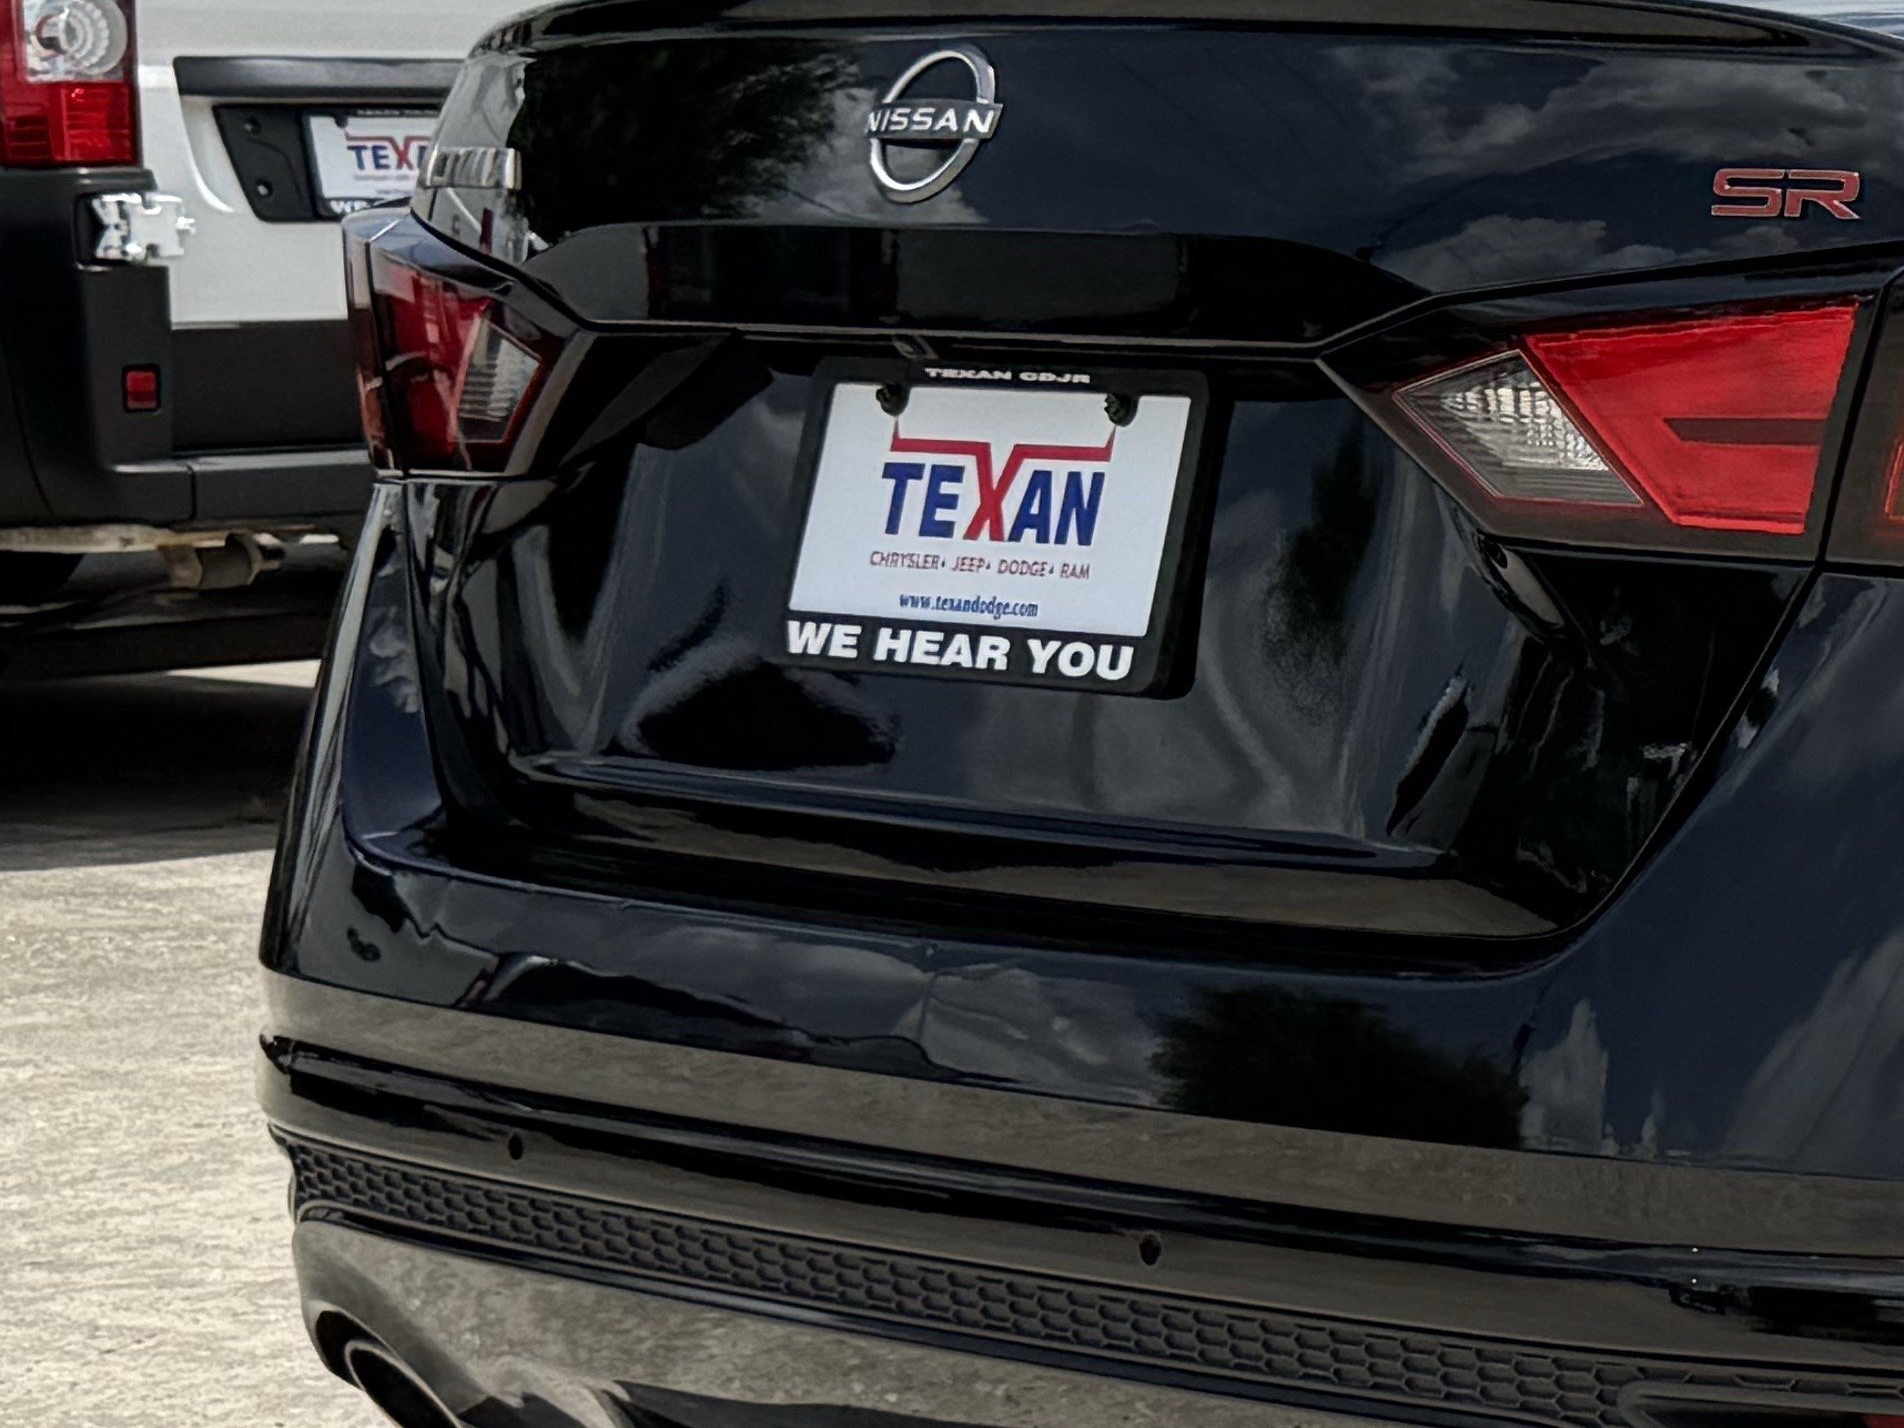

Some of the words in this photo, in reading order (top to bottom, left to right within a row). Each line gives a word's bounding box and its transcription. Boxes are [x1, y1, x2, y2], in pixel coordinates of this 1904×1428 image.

[865, 107, 994, 134] NISSAN
[1711, 168, 1860, 219] SR
[924, 368, 1012, 380] TEXAN
[881, 438, 1105, 546] TEXAN
[1060, 563, 1091, 580] RAM
[899, 593, 1039, 620] www.texandodge.com
[786, 620, 862, 659] WE
[873, 627, 1011, 671] HEAR
[1027, 639, 1134, 681] YOU
